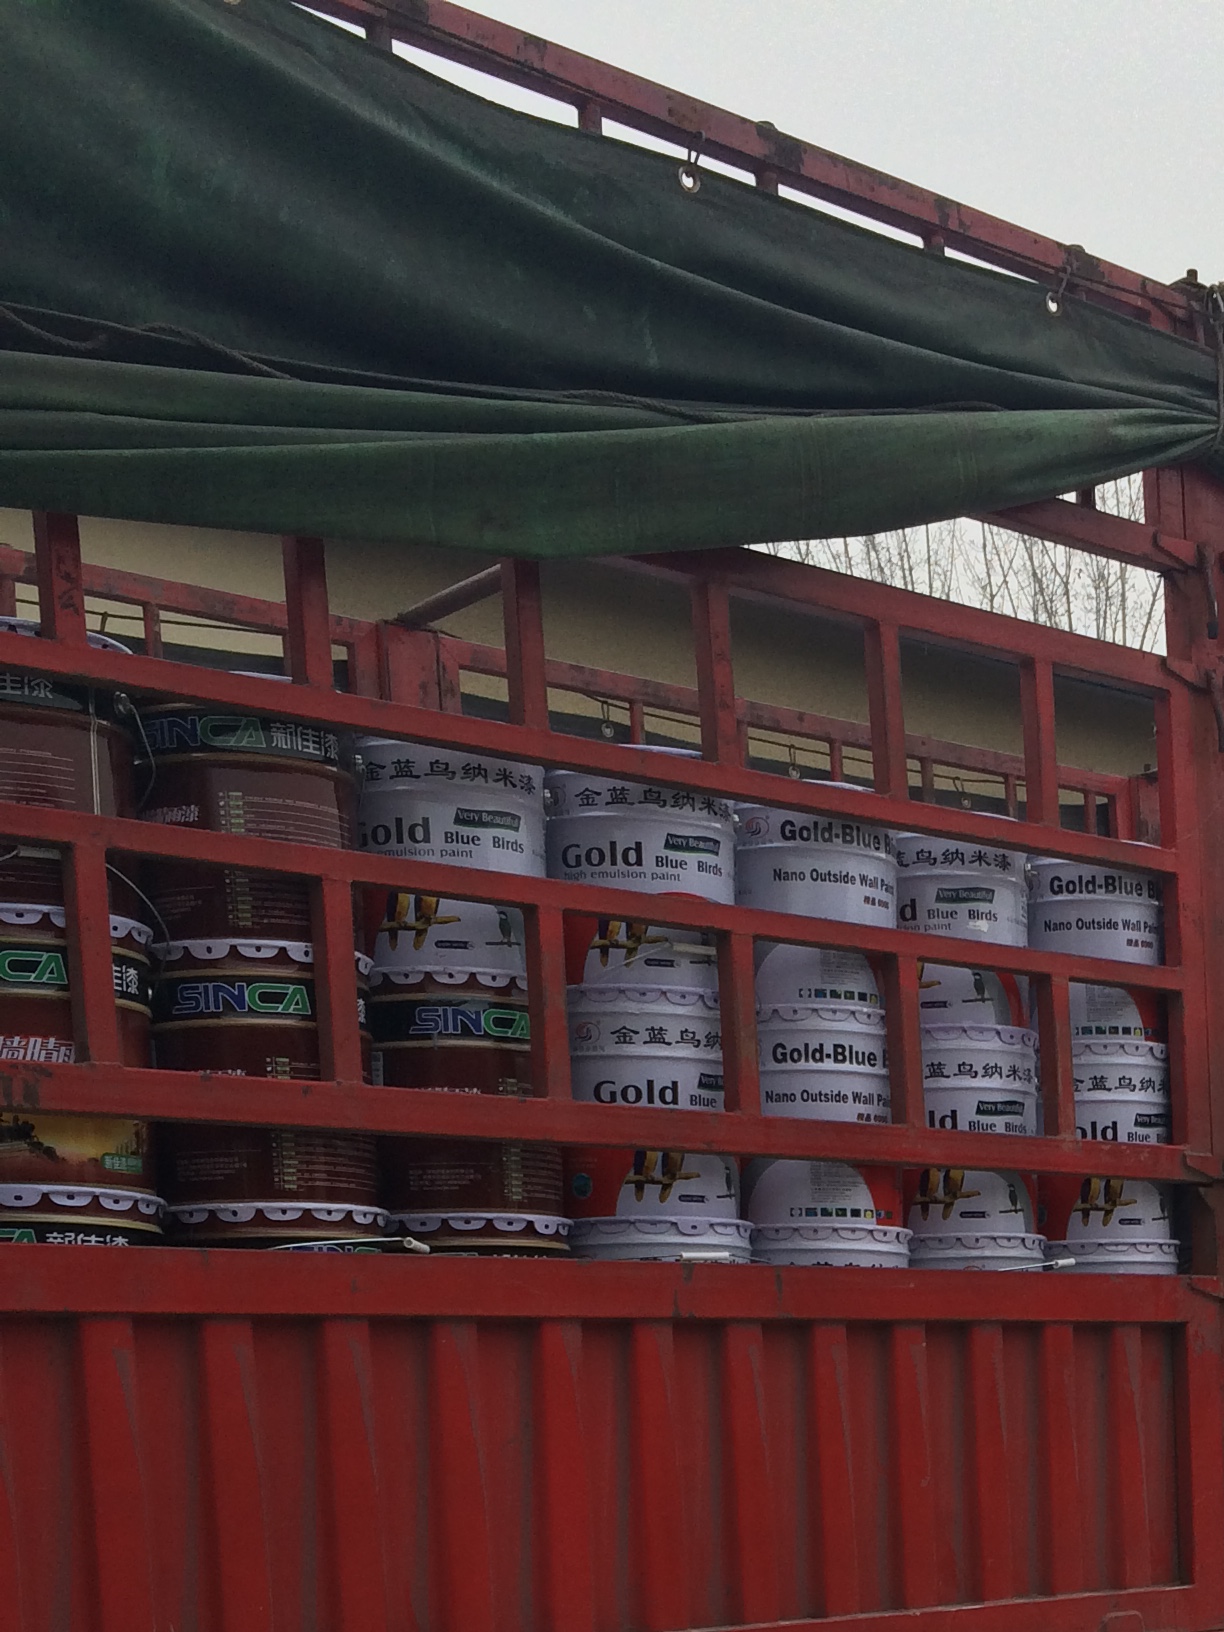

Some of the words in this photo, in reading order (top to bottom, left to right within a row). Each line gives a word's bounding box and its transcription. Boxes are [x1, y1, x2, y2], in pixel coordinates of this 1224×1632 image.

[364, 758, 536, 796] 金蓝鸟纳米漆
[573, 785, 731, 823] 金蓝鸟纳米漆
[444, 830, 481, 847] Blue
[491, 835, 525, 855] Birds
[779, 819, 881, 852] Gold-Blue
[439, 848, 474, 860] paint
[561, 840, 644, 869] Gold
[655, 855, 688, 871] Blue
[697, 860, 723, 877] Birds
[590, 868, 646, 880] emulsion
[651, 870, 681, 883] paint
[773, 868, 806, 883] Nano
[809, 867, 856, 886] Outside
[858, 872, 879, 890] Wall
[1048, 874, 1143, 898] Gold-Blue
[927, 907, 959, 920] Blue
[968, 909, 999, 922] Birds
[1043, 919, 1073, 933] Nano
[1075, 917, 1120, 931] Outside
[1121, 918, 1142, 933] Wall
[923, 922, 952, 933] paint
[172, 981, 311, 1016] SINCA
[409, 1006, 531, 1040] SINCA
[771, 1042, 877, 1068] Gold-Blue
[593, 1078, 680, 1106] Gold
[689, 1094, 717, 1109] Blue
[764, 1089, 797, 1105] Nano
[800, 1089, 849, 1105] Outside
[851, 1091, 875, 1106] Wall
[928, 1108, 958, 1131] ld
[968, 1119, 997, 1132] Blue
[1004, 1121, 1027, 1135] Birds
[1076, 1120, 1118, 1142] old
[1127, 1131, 1151, 1143] Blue
